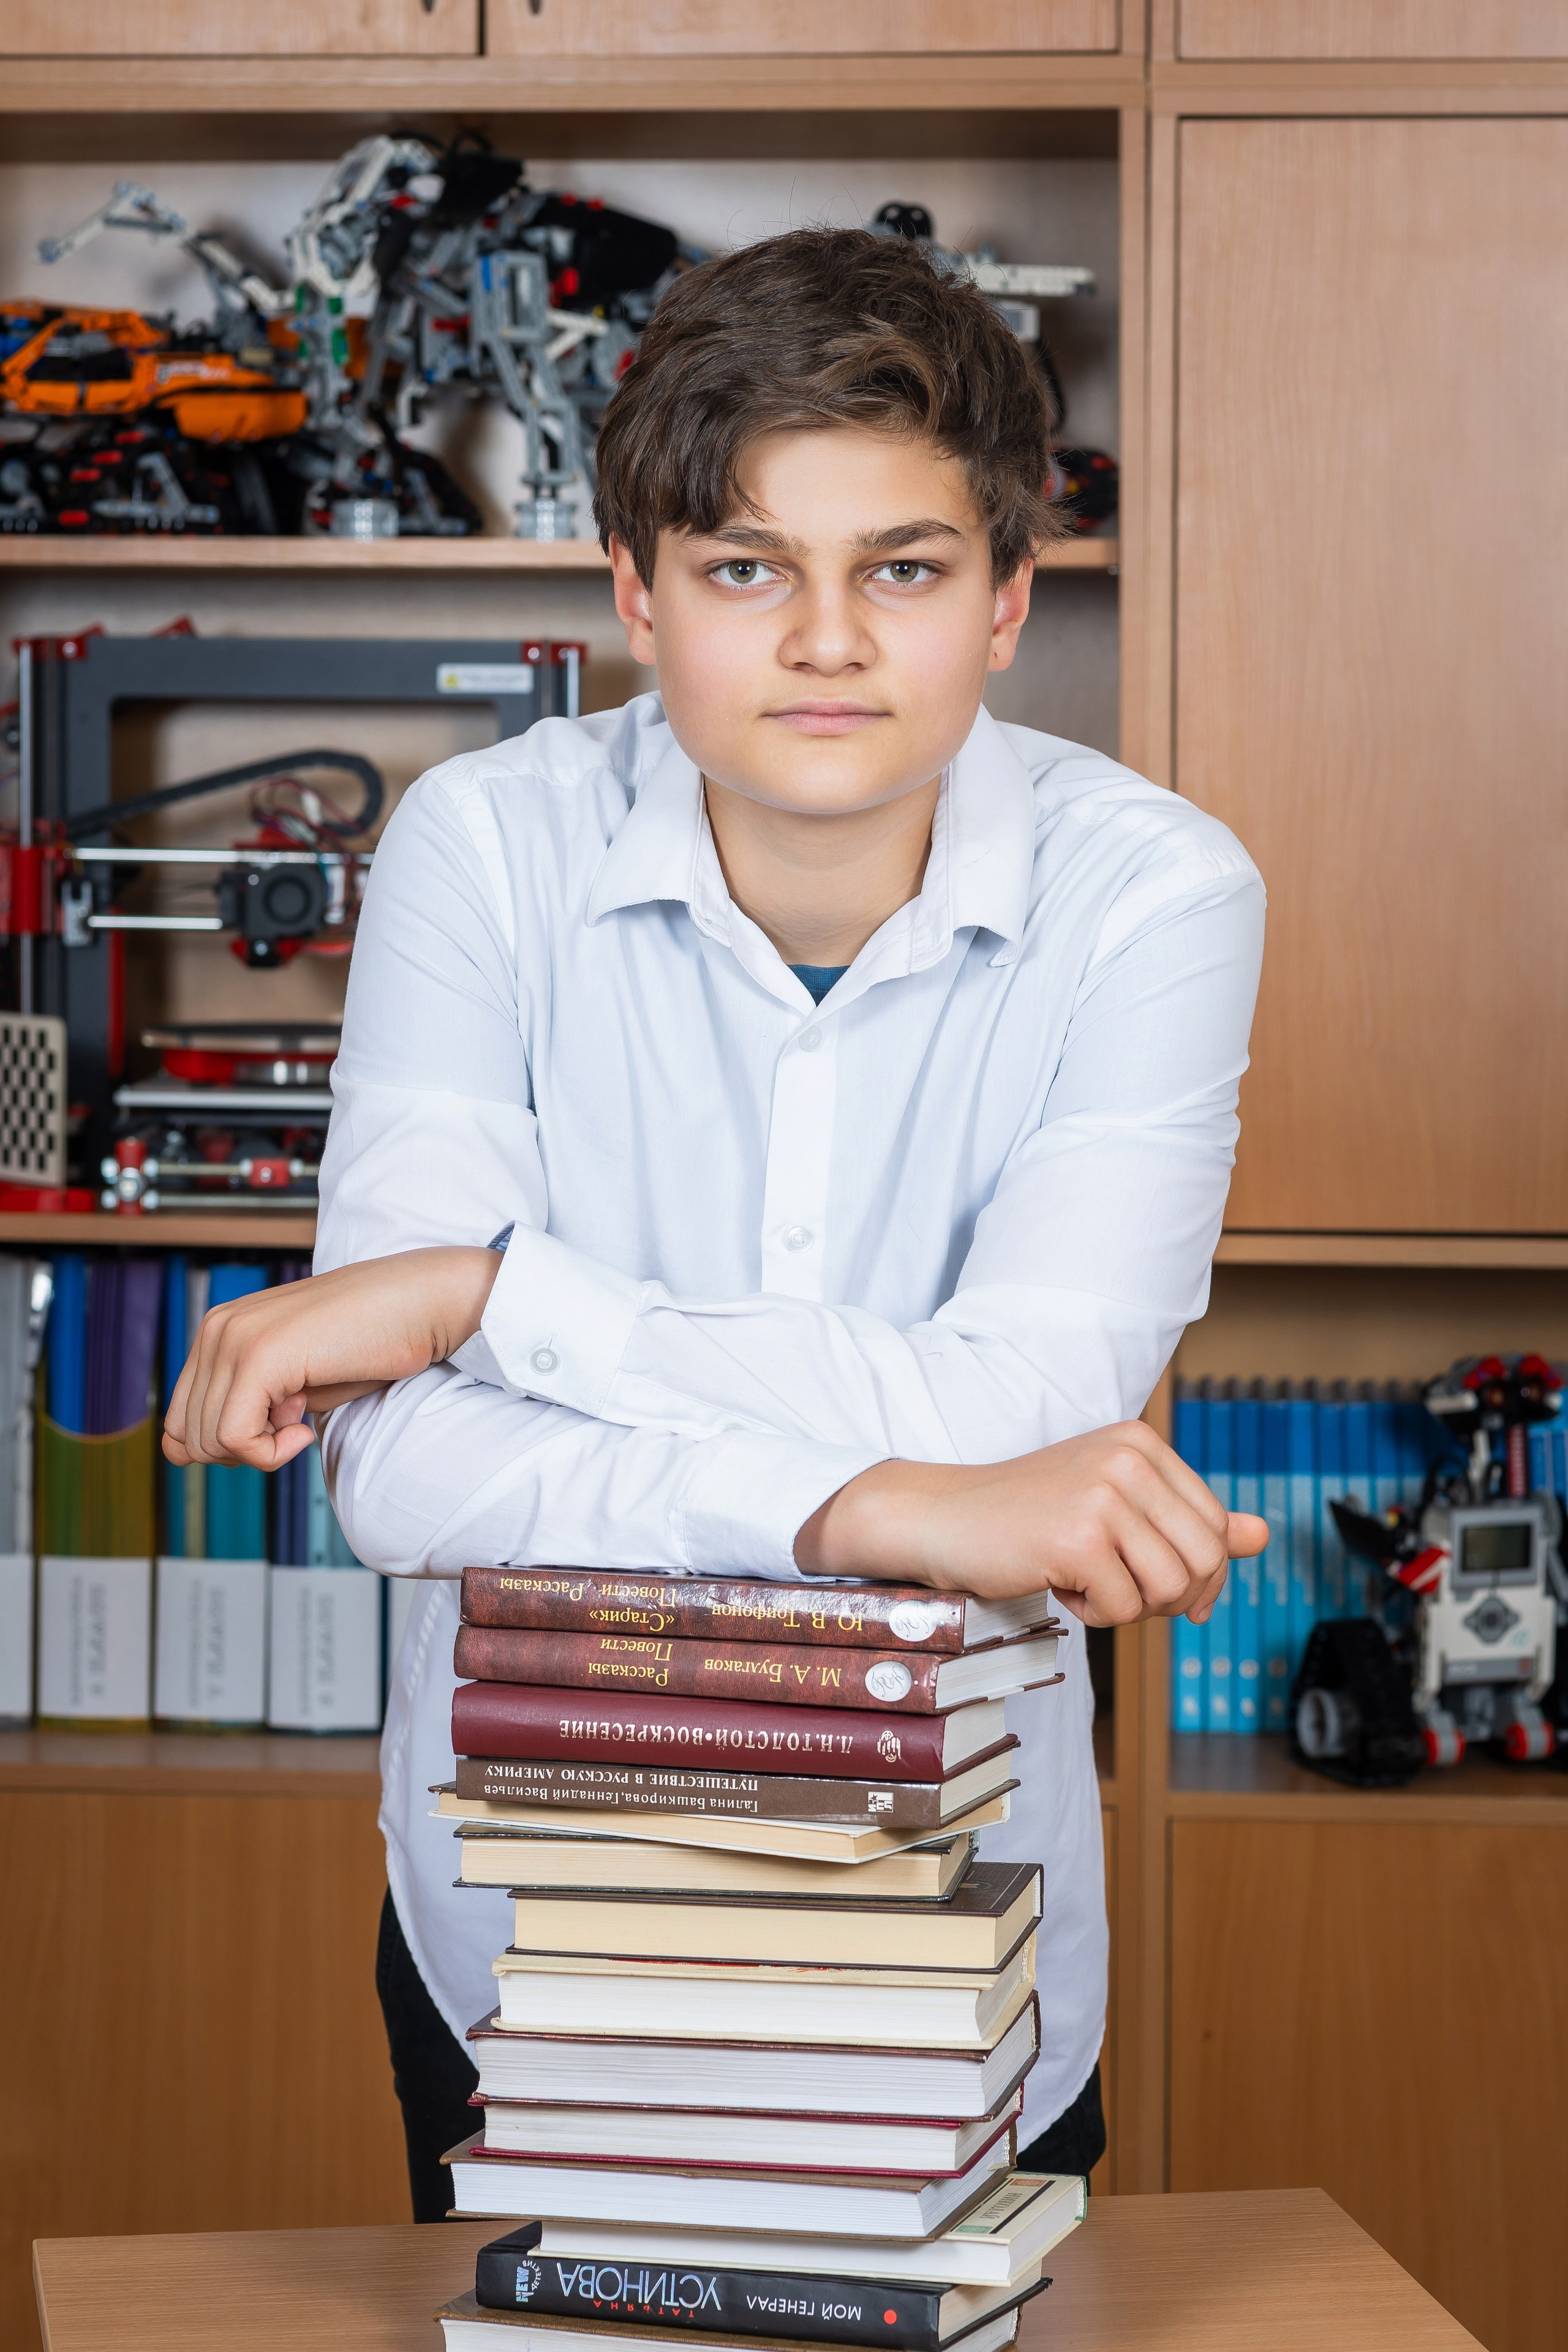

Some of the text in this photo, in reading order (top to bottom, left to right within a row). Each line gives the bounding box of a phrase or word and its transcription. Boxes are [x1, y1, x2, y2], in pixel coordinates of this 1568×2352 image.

[499, 1577, 677, 1607] Повести Рассказы
[589, 1607, 674, 1631] «Старик»
[712, 1603, 800, 1627] Трифонов
[600, 1639, 674, 1661] Повести
[589, 1662, 669, 1686] Рассказы
[705, 1658, 842, 1687] М. А. Булгаков
[558, 1719, 703, 1746] ВОСКРЕСЕНИЕ
[485, 1765, 758, 1792] ПУТЕШЕСТВИЕ В РУССКУЮ АМЕРИКУ
[484, 1785, 547, 1800] Васильев
[553, 1789, 618, 1804] Геннадий
[710, 1798, 757, 1812] Галина
[979, 2193, 1023, 2219] НИКОЛАЙ
[516, 2266, 534, 2302] NEW
[522, 2260, 541, 2291] ДЕТЕКТИВ
[557, 2262, 722, 2310] УСТИНОВА
[594, 2301, 693, 2317] ТАТЬЯНА
[747, 2295, 861, 2320] МОЙ ГЕНЕРАЛ
